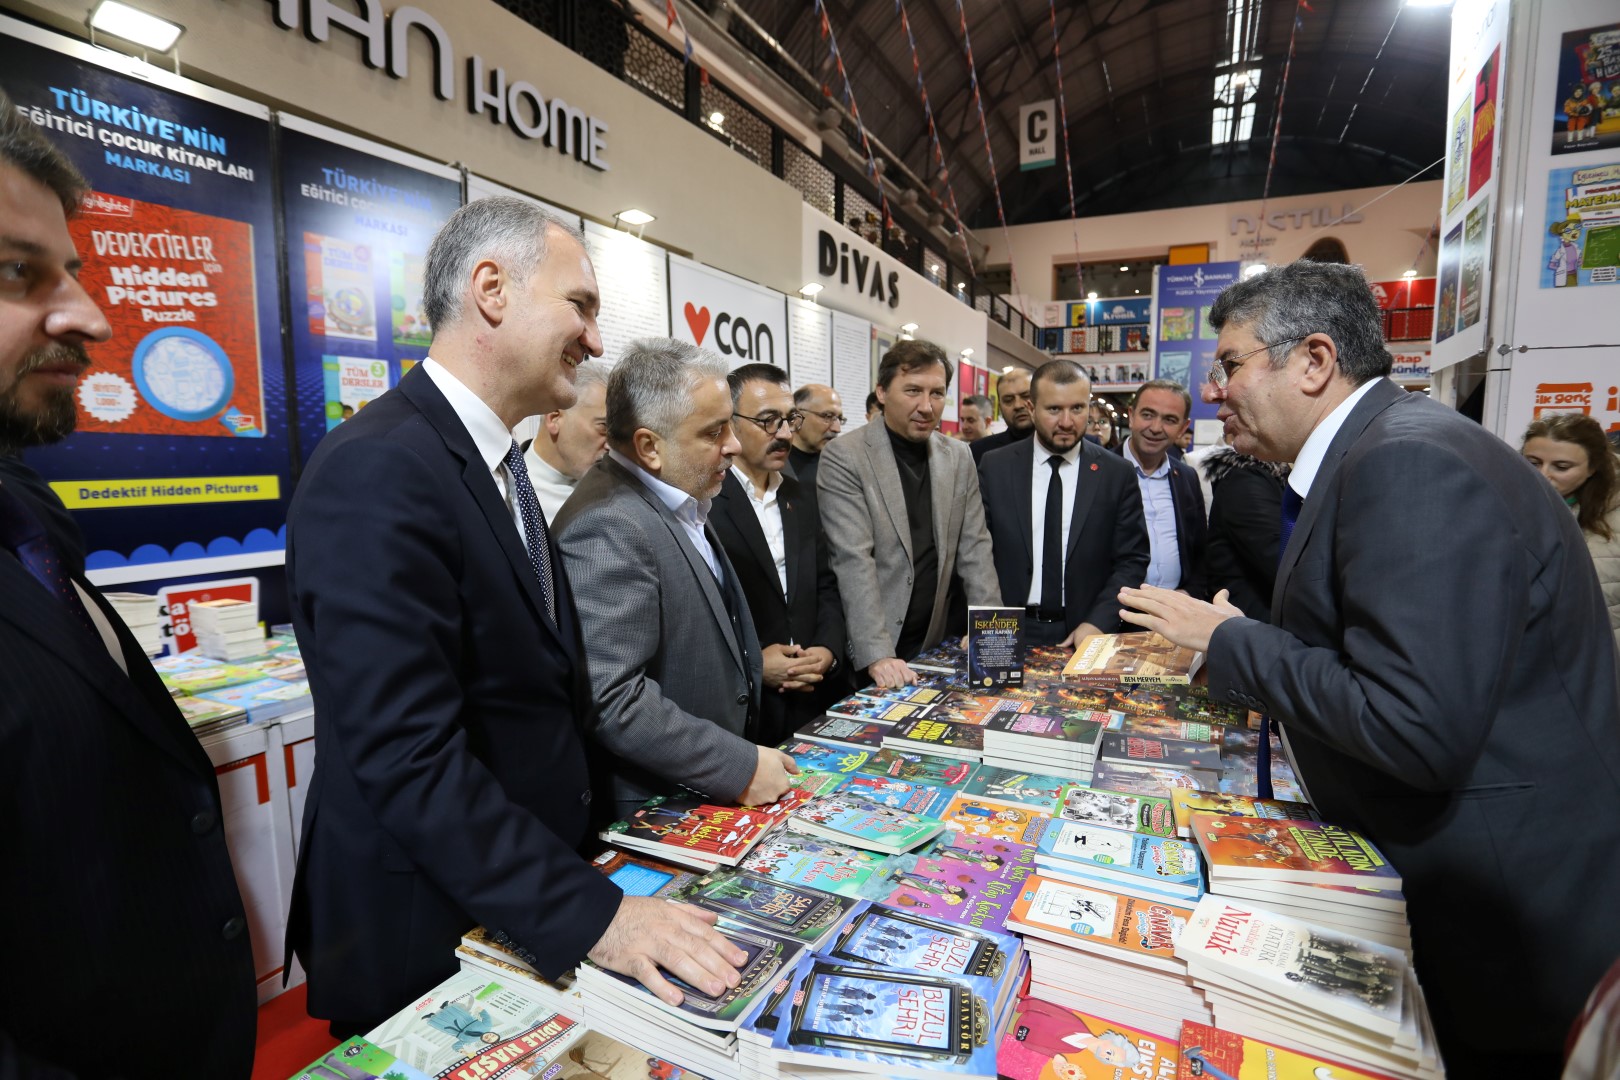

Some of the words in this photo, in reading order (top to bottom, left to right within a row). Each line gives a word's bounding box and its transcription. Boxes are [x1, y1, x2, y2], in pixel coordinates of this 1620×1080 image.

[49, 86, 227, 156] TÜRKİYE'NİN
[473, 55, 612, 171] HOME
[1027, 109, 1048, 144] C
[17, 105, 94, 140] EĞİTİCİ
[99, 128, 164, 160] ÇOCUK
[167, 147, 255, 182] KİTAPLARI
[1028, 145, 1046, 156] HALL
[105, 150, 190, 184] MARKASI
[301, 183, 349, 207] EĞİTİCİ
[91, 229, 217, 261] DEDEKTİFLER
[109, 264, 208, 287] Hidden
[106, 286, 218, 307] Pictures
[141, 308, 196, 322] Puzzle
[714, 312, 774, 364] can
[341, 377, 384, 389] DERSLER
[345, 366, 368, 378] TÜM
[374, 364, 382, 375] 3
[1555, 394, 1592, 405] genç
[79, 486, 147, 500] Dedektif
[152, 485, 201, 497] Hidden
[205, 483, 259, 494] Pictures
[1205, 905, 1252, 955] Nutuk
[1258, 924, 1284, 965] ATATÜRK
[942, 937, 971, 975] BUZU
[891, 988, 918, 1039] ŞEHRİ
[917, 988, 943, 1044] BUZUL
[960, 990, 969, 1051] ASANSÖR
[521, 1021, 563, 1047] ADİLE
